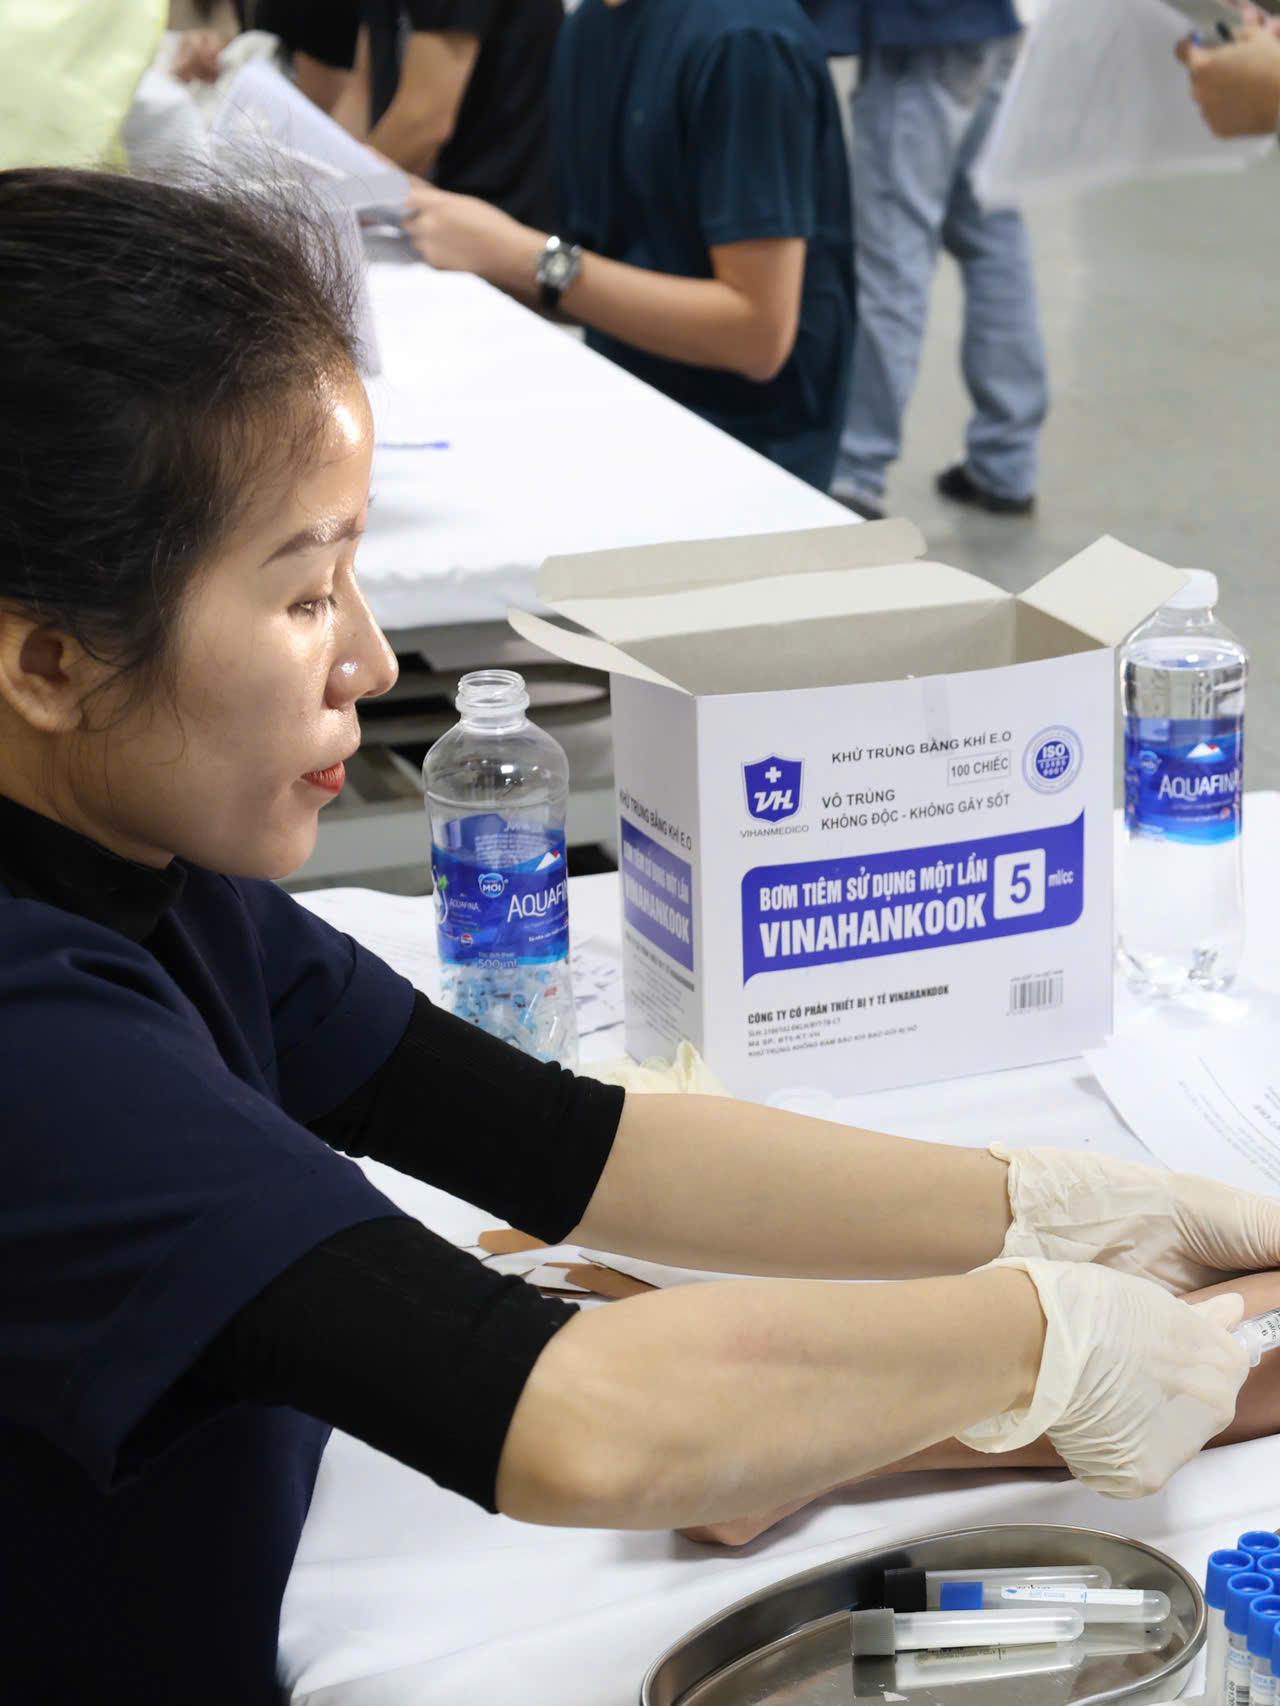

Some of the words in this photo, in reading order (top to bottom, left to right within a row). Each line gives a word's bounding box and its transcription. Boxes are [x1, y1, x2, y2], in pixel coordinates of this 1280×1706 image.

[1043, 744, 1065, 758] ISO
[951, 763, 970, 778] 100
[822, 792, 842, 808] VÔ
[847, 788, 896, 806] TRÙNG
[821, 813, 868, 830] KHÔNG
[871, 808, 899, 827] ĐỘC
[910, 802, 954, 819] KHÔNG
[987, 789, 1010, 808] SỐT
[740, 825, 809, 838] VIHANMEDICO
[759, 882, 799, 912] BƠM
[802, 876, 842, 907] TIÊM
[846, 865, 871, 902] SỬ
[872, 869, 917, 902] DỤNG
[920, 860, 955, 895] MỘT
[956, 851, 988, 887] LẦN
[1009, 862, 1032, 904] 5
[759, 892, 988, 959] VINAHANKOOK
[748, 1011, 773, 1025] CÔNG
[776, 1009, 787, 1021] TY
